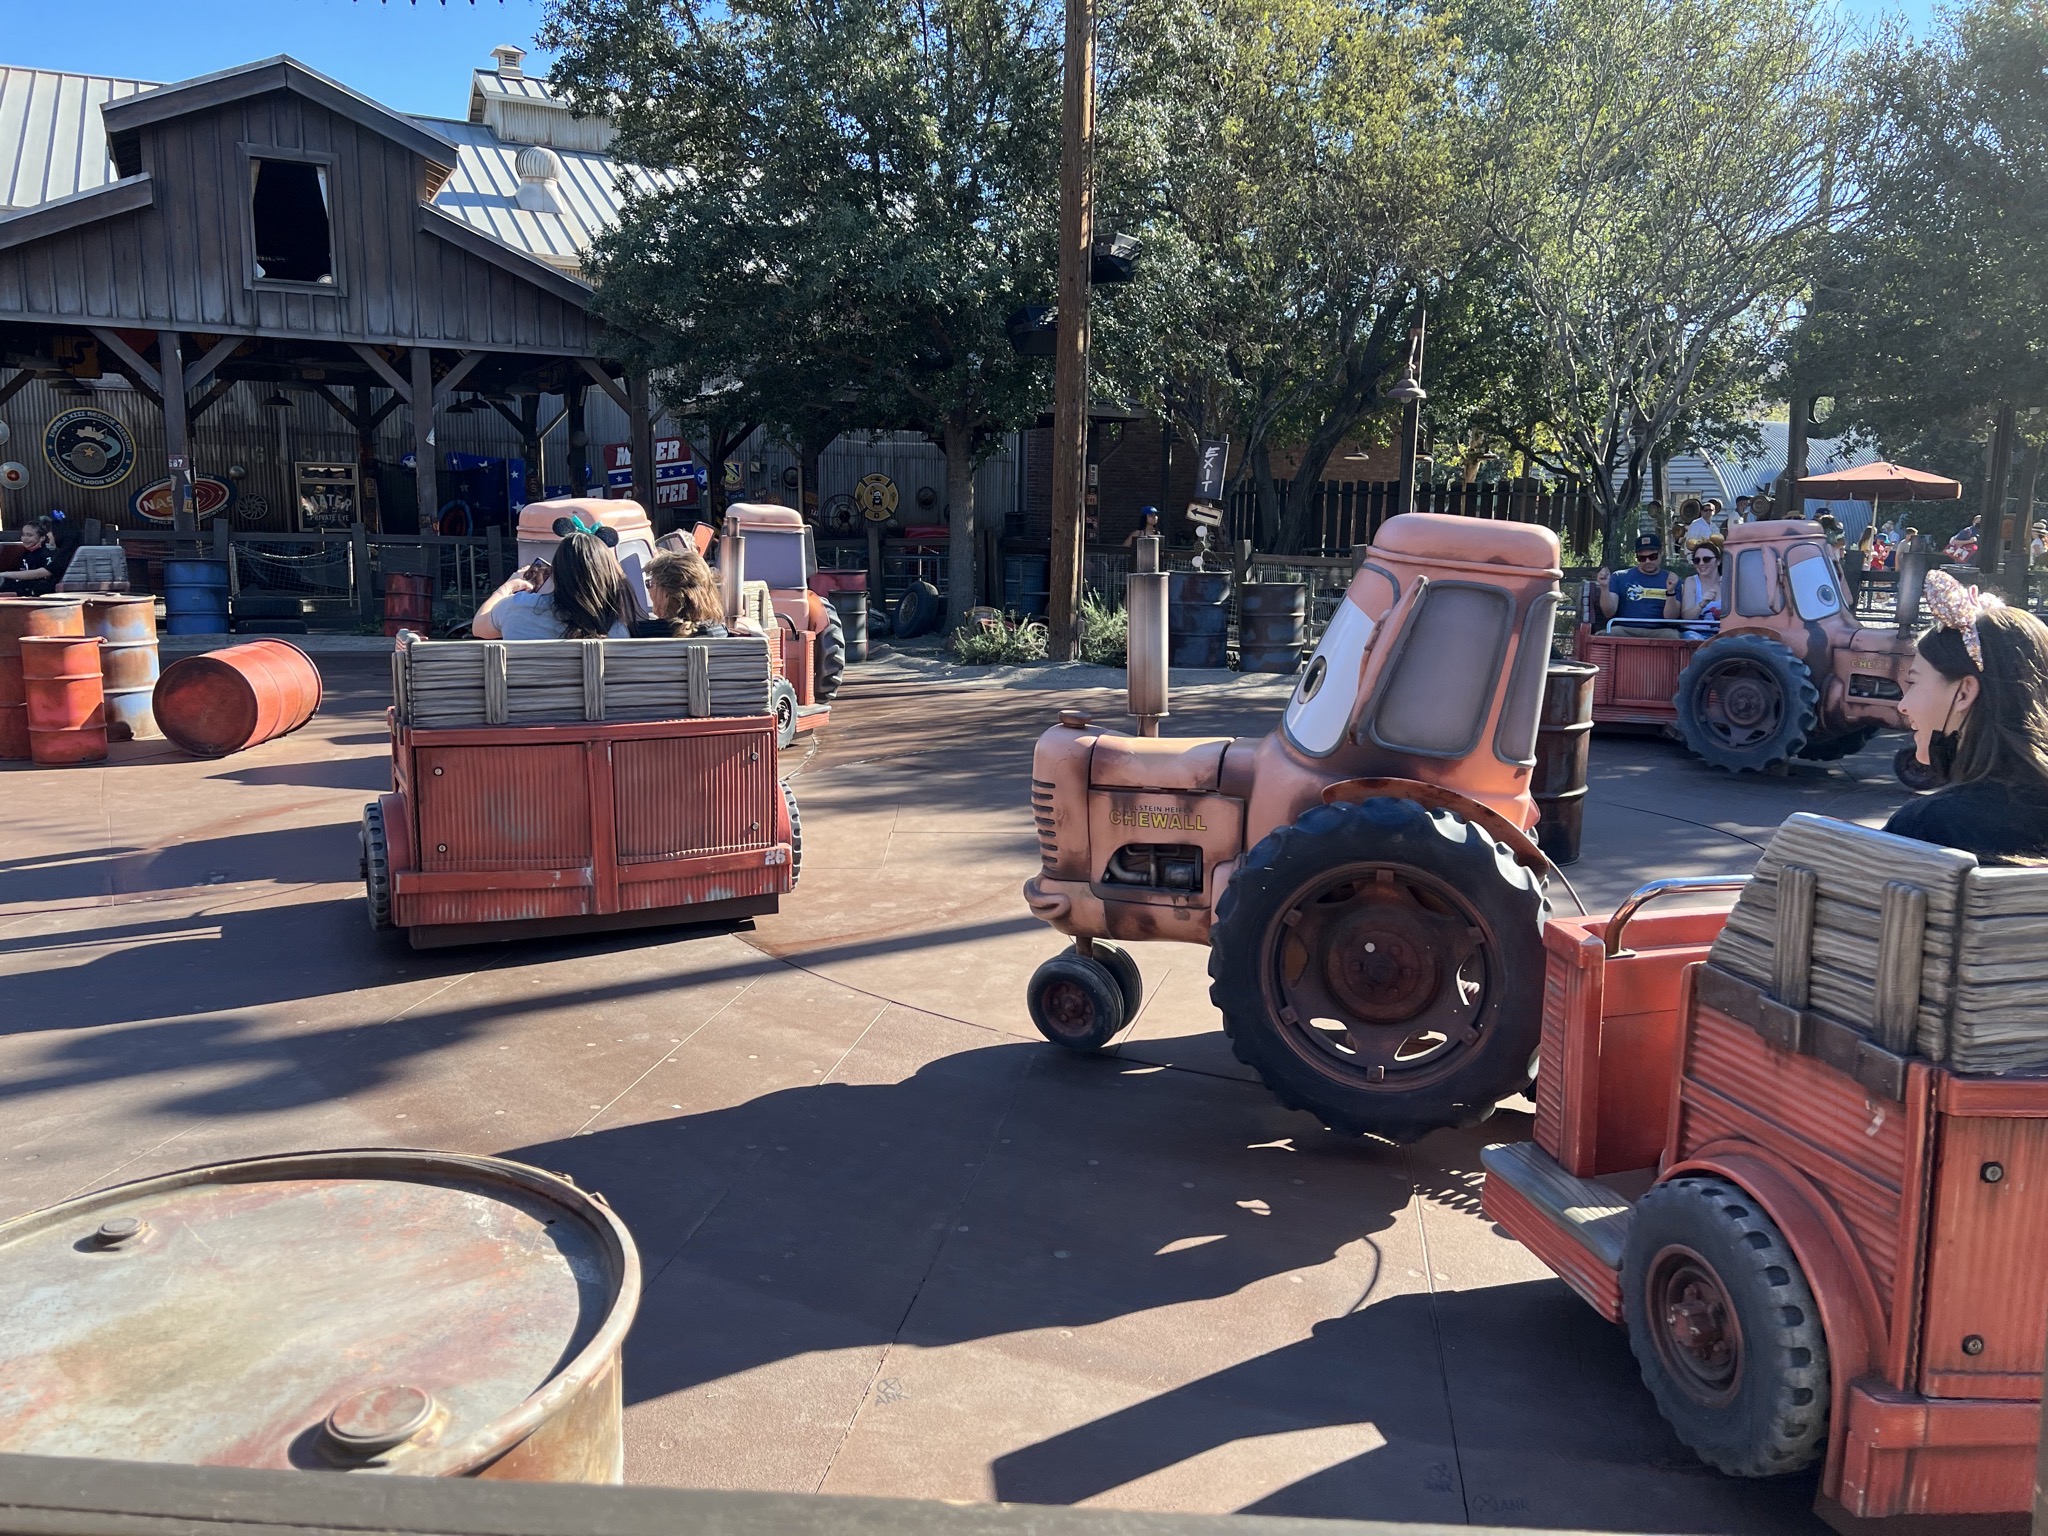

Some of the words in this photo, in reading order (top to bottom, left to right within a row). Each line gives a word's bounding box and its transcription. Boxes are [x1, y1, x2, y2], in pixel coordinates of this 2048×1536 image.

[48, 416, 69, 438] IMPALA
[69, 411, 86, 419] XIII
[87, 411, 116, 425] RESCUE
[115, 424, 133, 453] MISSION
[615, 440, 681, 467] MER
[50, 456, 82, 483] OPERATION
[105, 468, 126, 483] MATER
[1201, 446, 1221, 493] EXIT
[310, 513, 337, 523] PRIVATE
[337, 513, 350, 523] EYE
[1109, 809, 1208, 831] CHEWALL
[1164, 805, 1195, 815] HEIFER
[764, 849, 786, 866] 26
